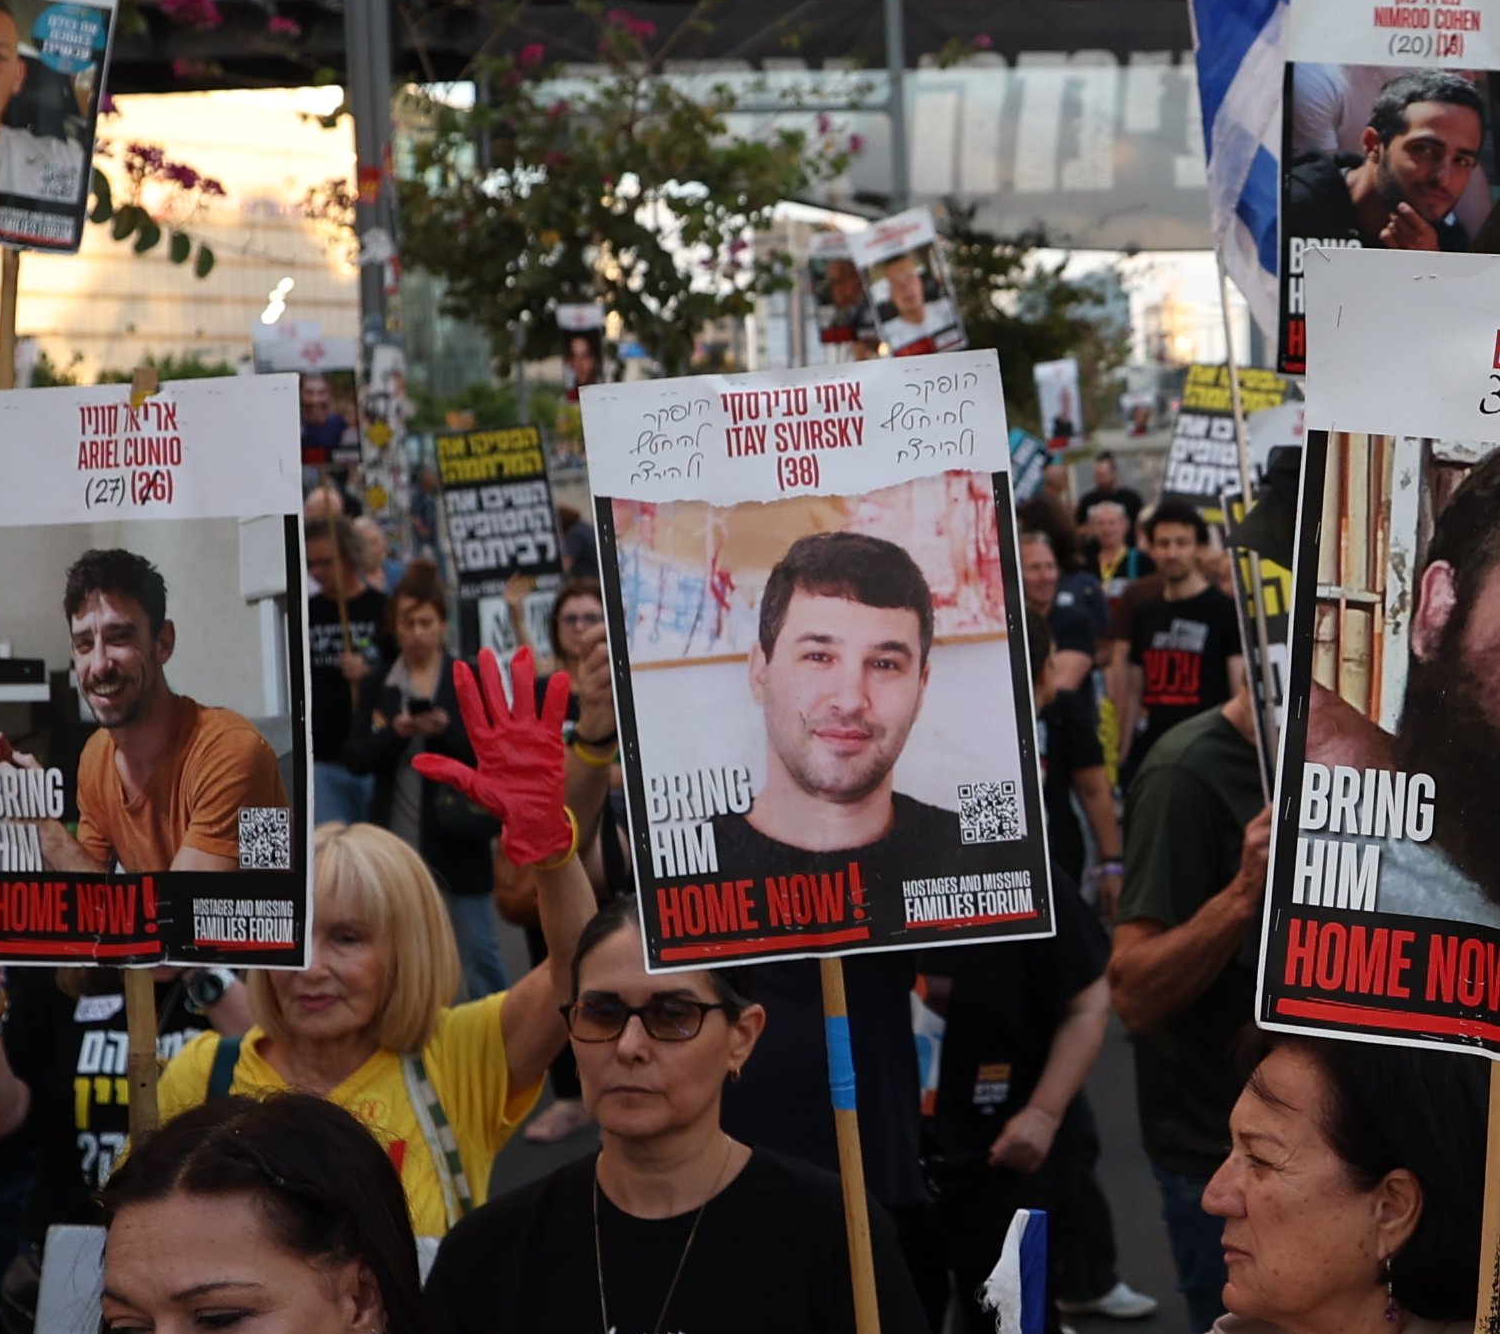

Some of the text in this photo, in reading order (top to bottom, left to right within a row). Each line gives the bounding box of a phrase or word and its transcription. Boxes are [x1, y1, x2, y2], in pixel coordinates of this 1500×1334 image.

[1374, 6, 1481, 32] NIMROD COHEN
[1388, 32, 1433, 58] (20)
[78, 403, 119, 439] קוניו
[720, 380, 864, 426] איתי סבירסקי
[77, 436, 182, 471] ARIEL CUNIO
[725, 416, 865, 458] ITAY SVIRSKY
[85, 476, 126, 507] (27)
[130, 470, 174, 506] (26)
[776, 453, 820, 492] (38)
[648, 764, 754, 826] BRING
[1299, 761, 1438, 844] BRING
[652, 821, 719, 880] HIM
[902, 869, 1031, 898] HOSTAGES AND MISSING
[1291, 835, 1382, 914] HIM
[76, 877, 158, 935] NOW!
[193, 897, 294, 919] HOSTAGES AND MISSING
[655, 861, 867, 940] HOME NOW!
[904, 886, 1033, 924] FAMILIES FORUM
[193, 917, 294, 944] FAMILIES FORUM
[1283, 918, 1414, 999] HOME
[76, 1029, 129, 1075] הם
